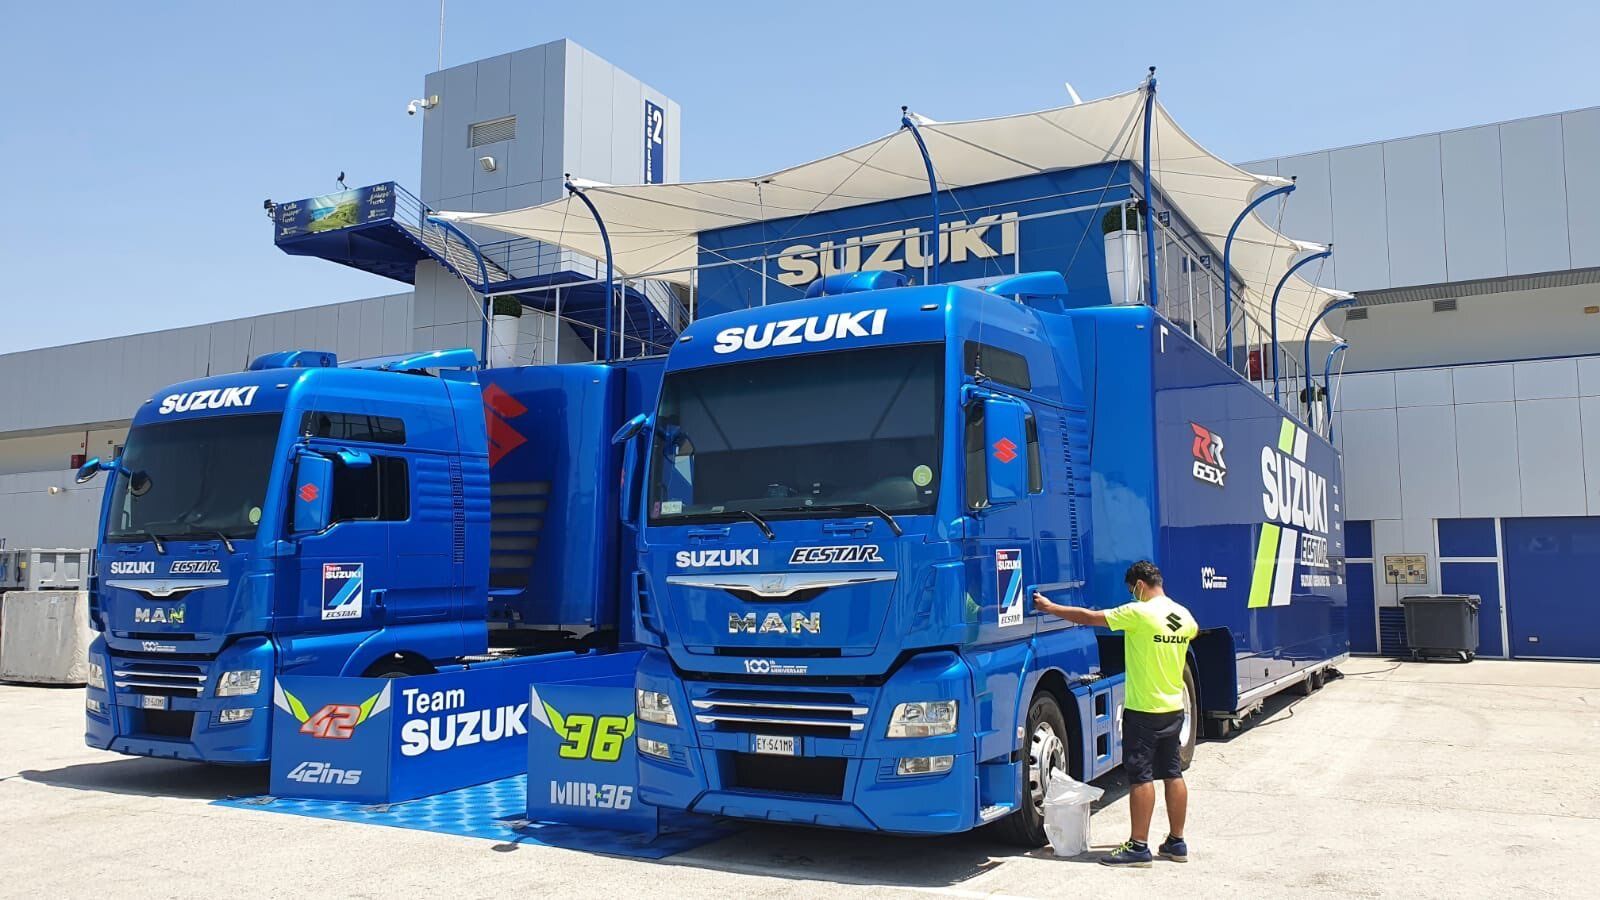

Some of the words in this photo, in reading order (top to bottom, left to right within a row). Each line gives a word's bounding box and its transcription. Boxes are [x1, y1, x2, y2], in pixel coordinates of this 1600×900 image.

[653, 110, 662, 144] 2
[777, 212, 1019, 287] SUZUKI
[713, 309, 887, 354] SUZUKI
[159, 385, 259, 415] SUZUKI
[1193, 460, 1226, 486] GSX
[1262, 446, 1328, 533] SUZUKI
[111, 562, 155, 574] SUZUKI
[169, 560, 222, 574] ECSTAR
[676, 549, 759, 567] SUZUKI
[789, 545, 884, 564] ECSTAR
[998, 560, 1021, 570] SUZUKI
[326, 571, 361, 579] SUZUKI
[135, 607, 184, 623] MAN
[326, 610, 358, 618] ECSTAR
[728, 612, 820, 633] MAN
[1153, 634, 1189, 644] SUZUK
[402, 688, 465, 714] Team
[299, 704, 362, 739] 42
[401, 703, 528, 757] SUZUK
[559, 713, 628, 762] 36
[287, 761, 361, 785] 42ins
